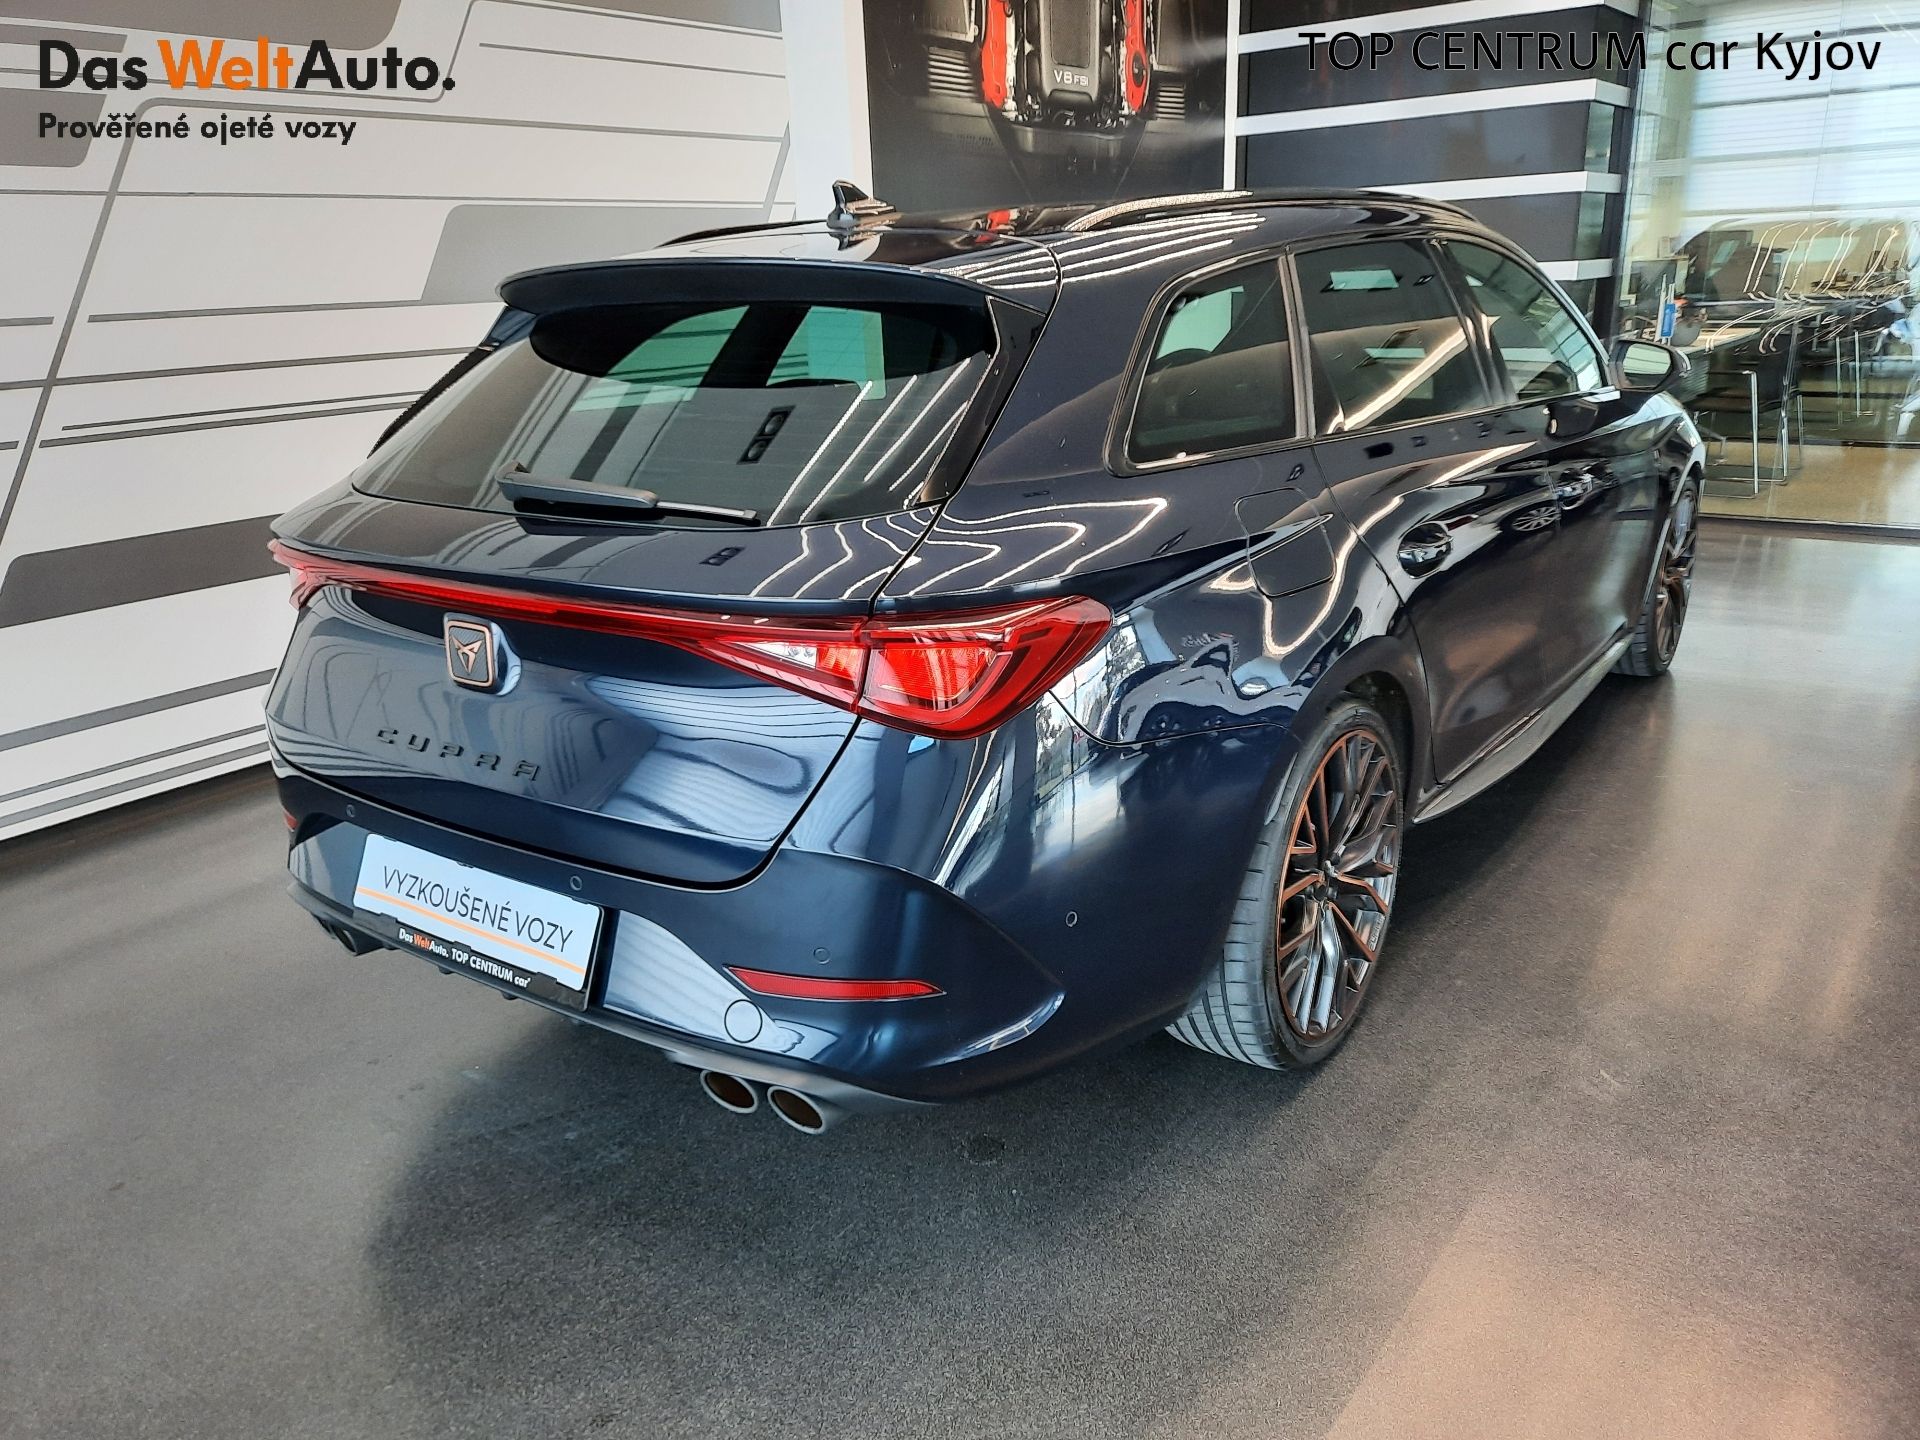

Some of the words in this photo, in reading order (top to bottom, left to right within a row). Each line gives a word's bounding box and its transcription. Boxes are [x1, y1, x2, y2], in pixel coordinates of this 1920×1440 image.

[1053, 69, 1073, 85] V8
[1073, 74, 1089, 87] FSI
[377, 728, 541, 782] CUPRA
[384, 865, 512, 933] VYZKOUŠENÉ
[515, 910, 574, 953] VOZY
[399, 927, 414, 944] Das
[451, 948, 469, 965] TOP
[469, 955, 513, 983] CENTRUM
